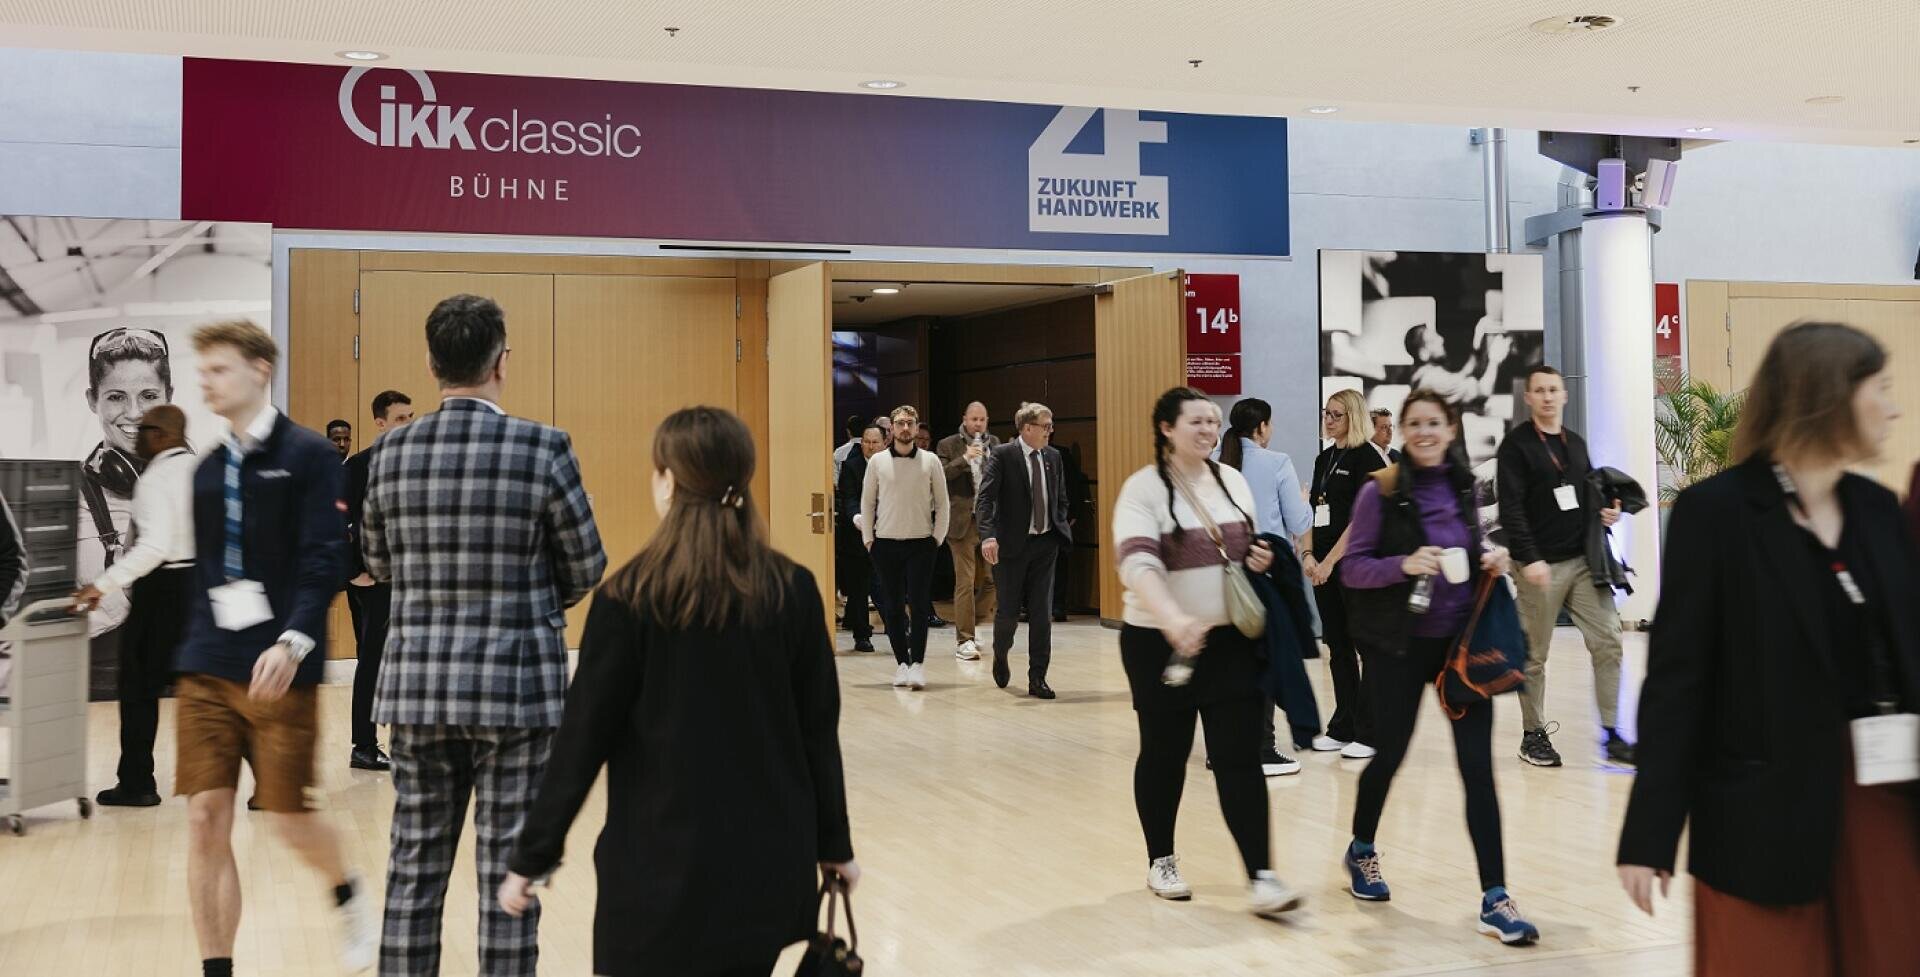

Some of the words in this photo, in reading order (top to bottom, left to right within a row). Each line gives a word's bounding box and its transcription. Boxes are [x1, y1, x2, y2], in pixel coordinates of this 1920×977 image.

[480, 108, 642, 158] classic
[449, 172, 570, 202] BÜHNE
[1036, 177, 1137, 199] ZUKUNFT
[1036, 197, 1160, 220] HANDWERK
[1656, 314, 1679, 339] 4c
